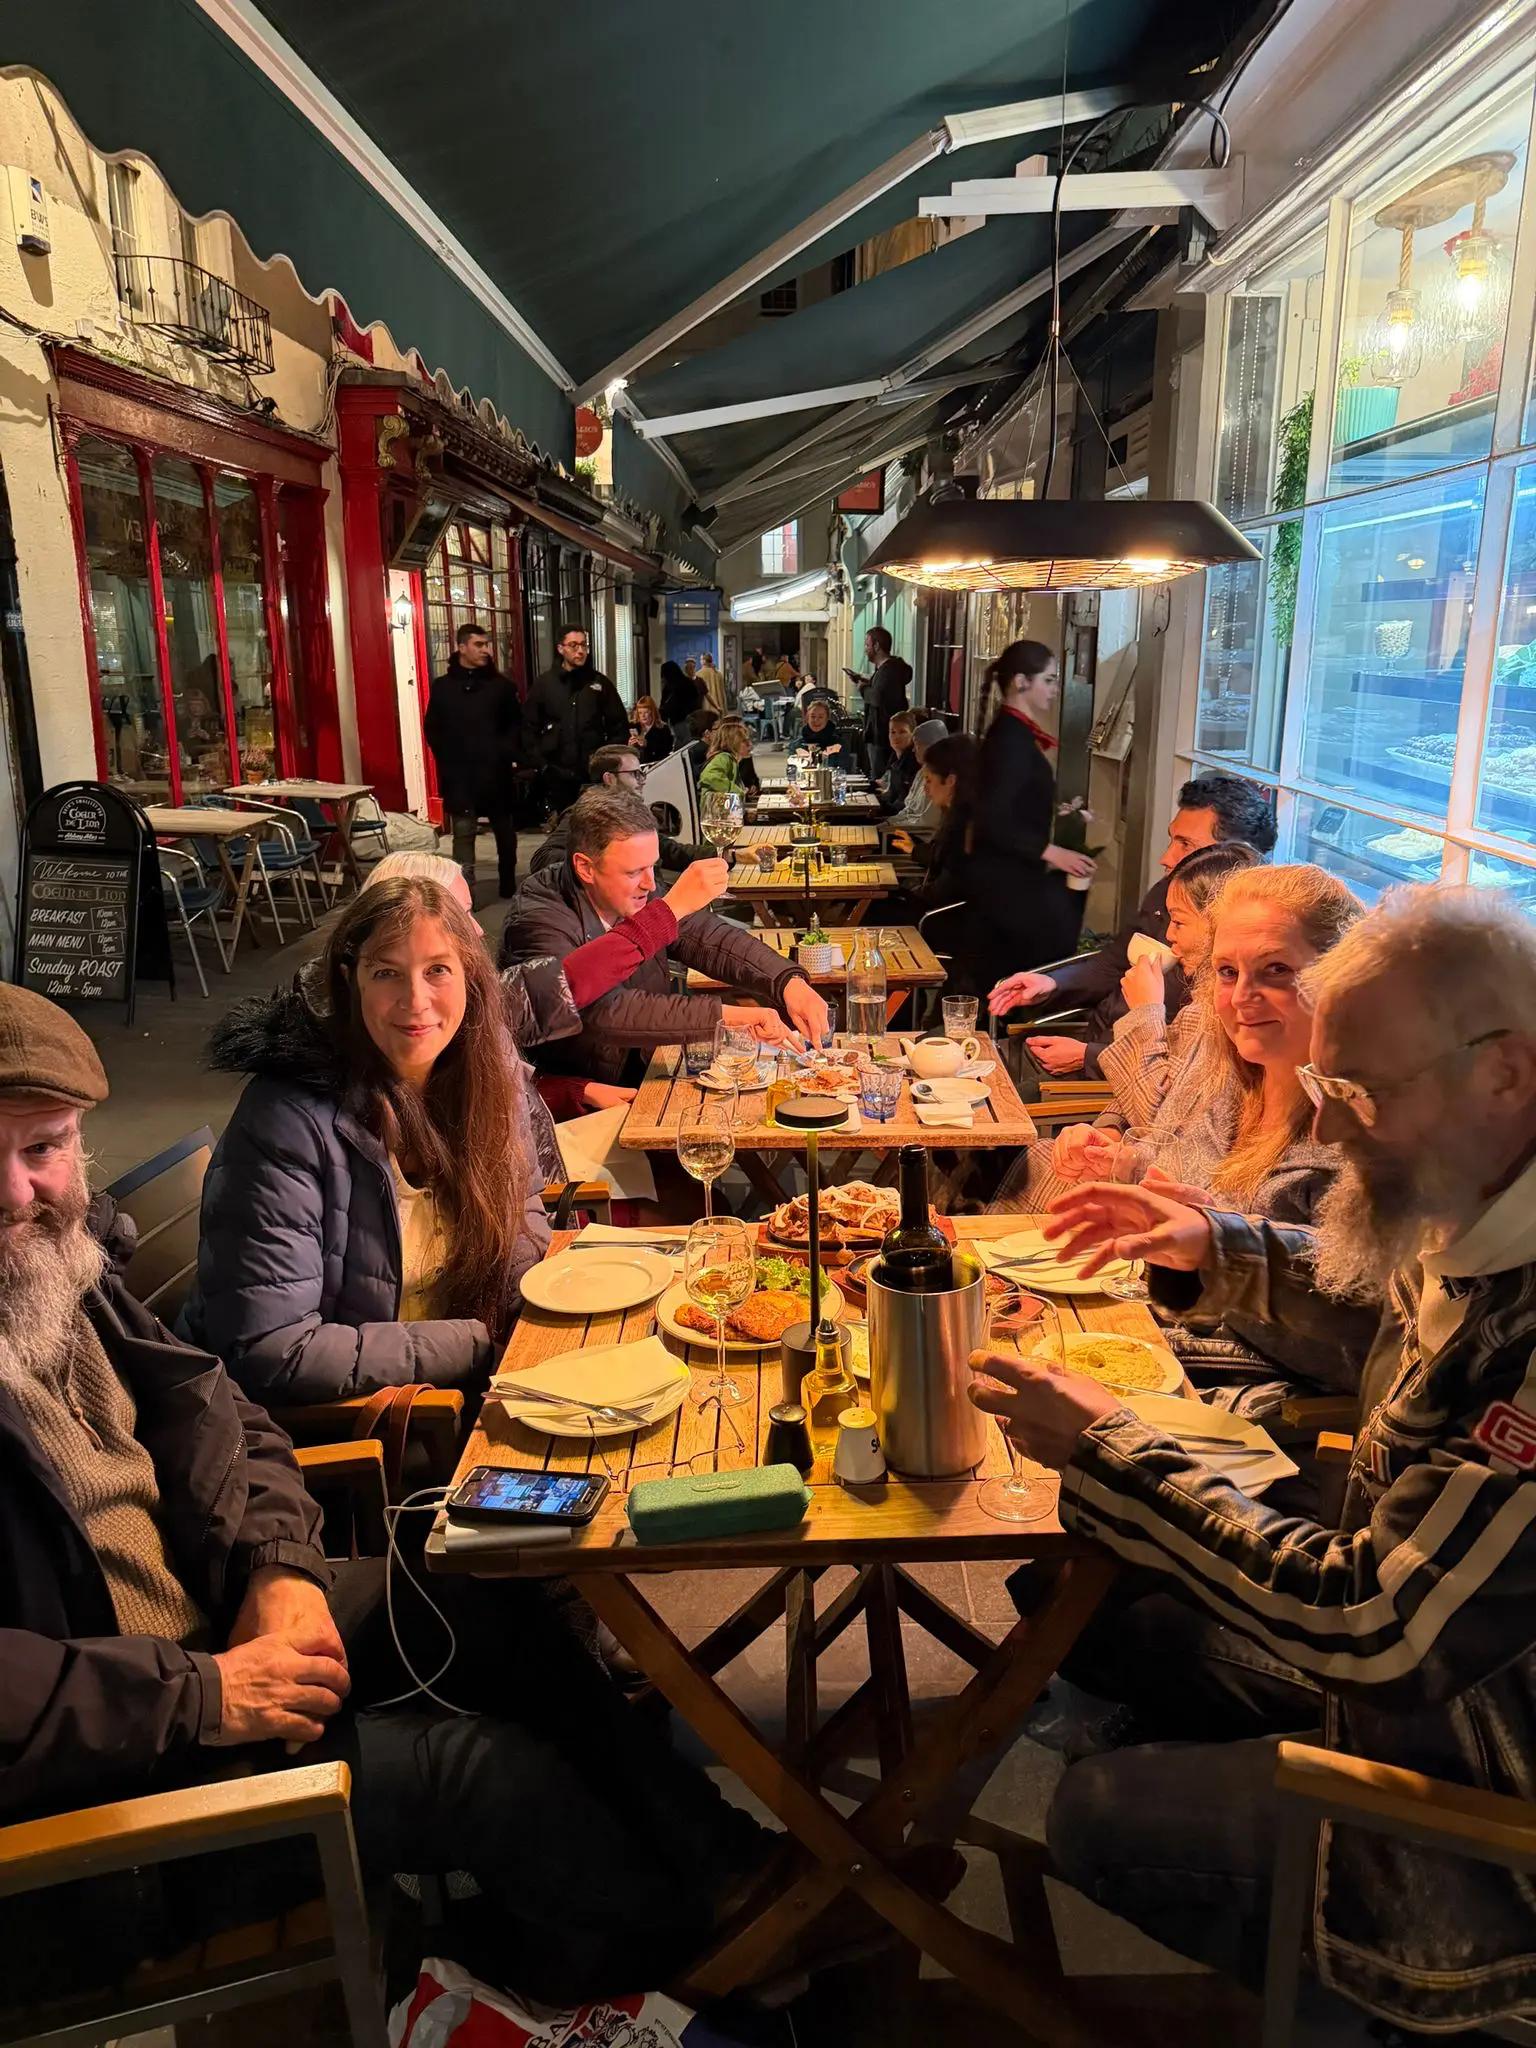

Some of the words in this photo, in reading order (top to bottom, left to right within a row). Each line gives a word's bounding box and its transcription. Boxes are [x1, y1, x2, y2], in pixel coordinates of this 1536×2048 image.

[34, 860, 101, 879] Welcome
[30, 908, 88, 924] BREAKFAST
[28, 933, 56, 948] MAIN
[55, 935, 86, 950] MENU
[28, 957, 75, 984] Sunday
[77, 960, 124, 977] ROAST
[46, 980, 72, 996] 12pm
[81, 981, 102, 997] 5pm
